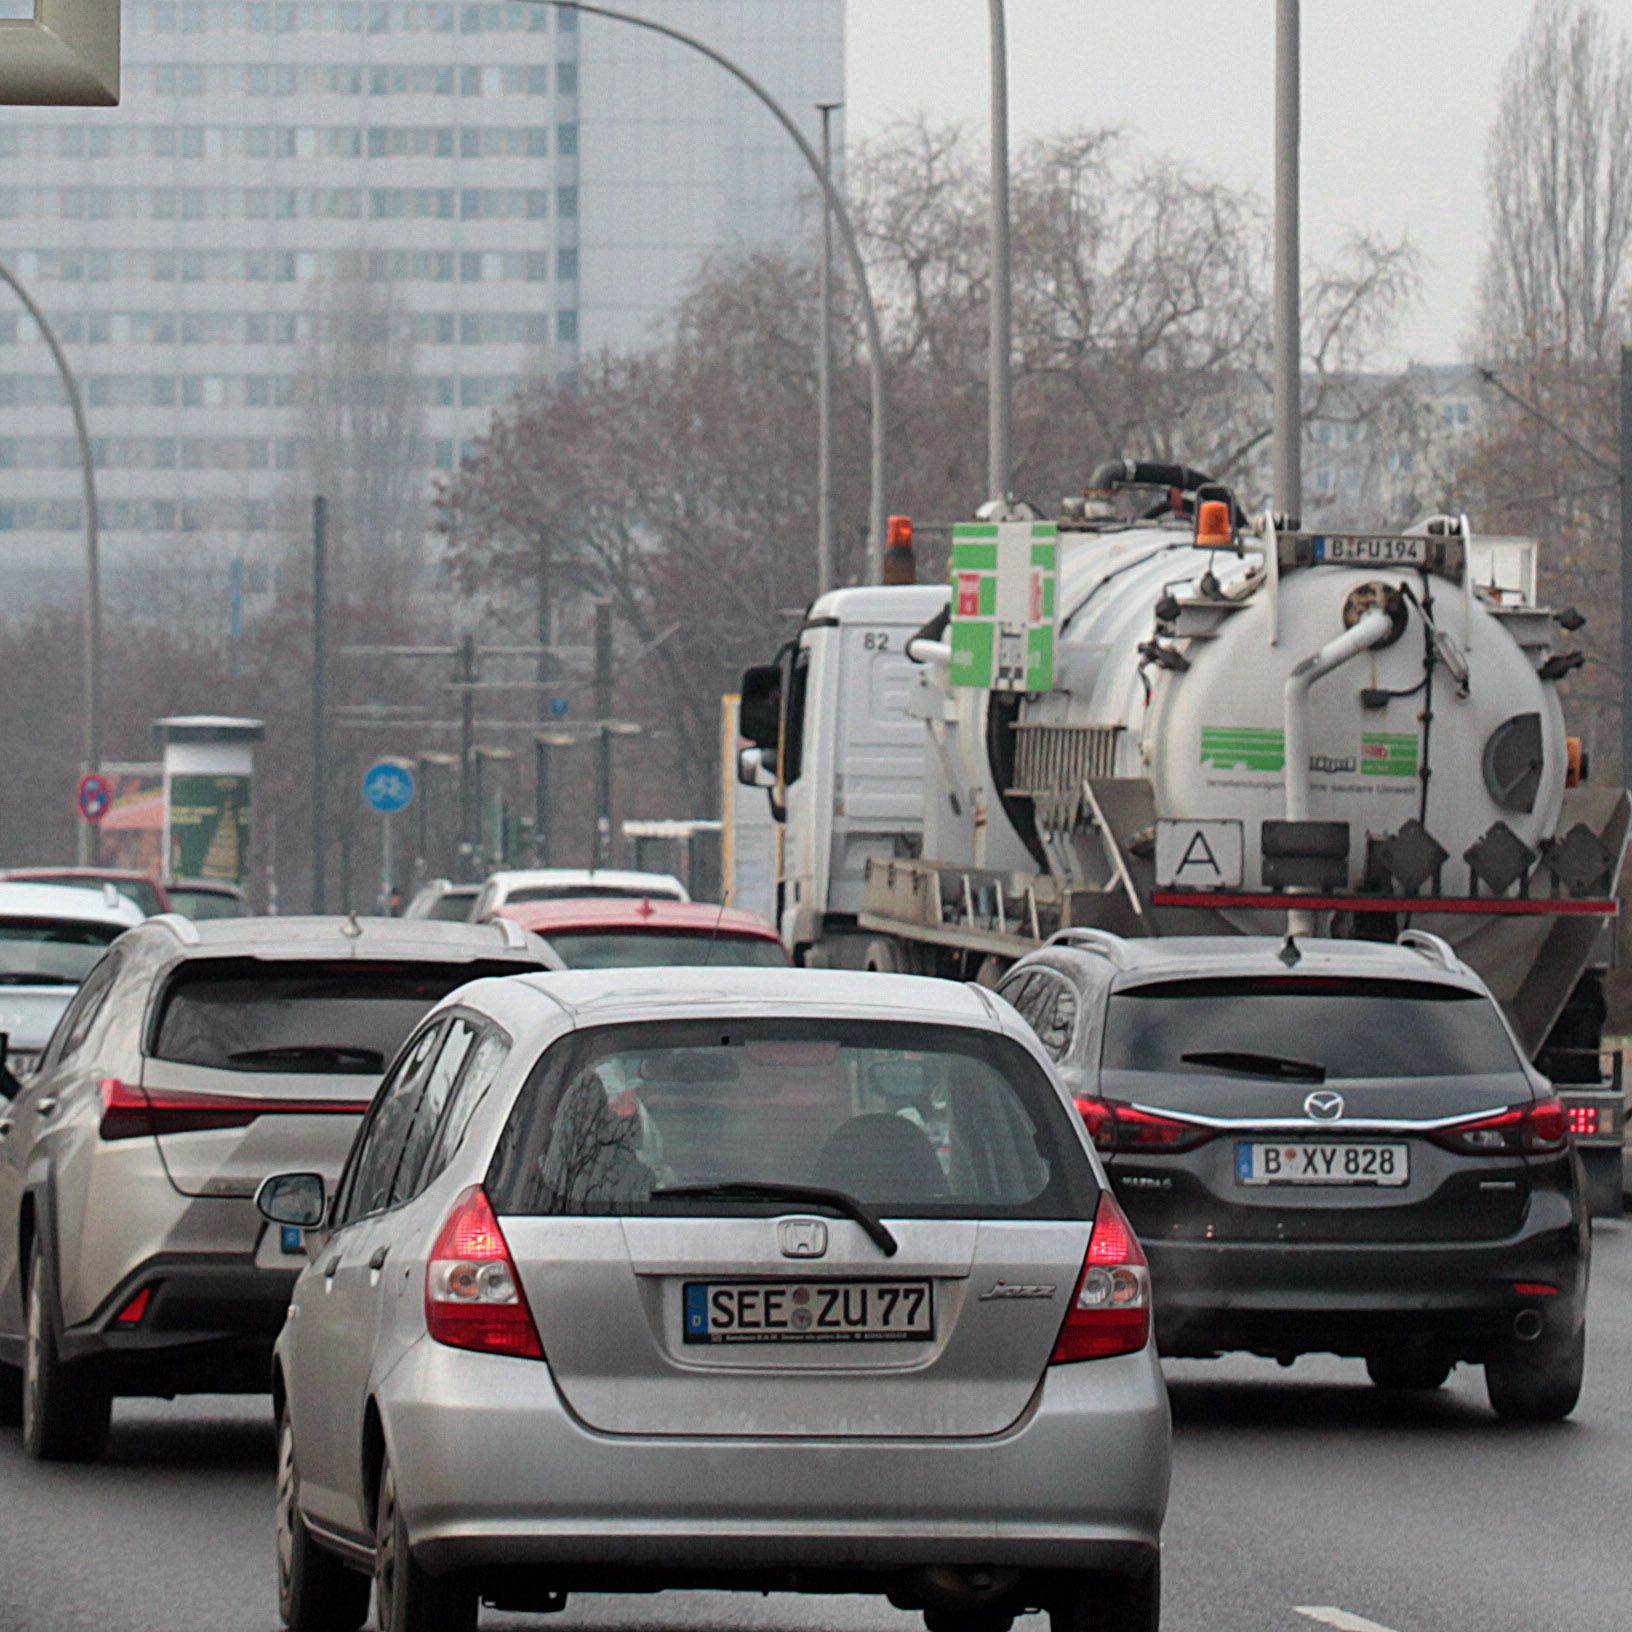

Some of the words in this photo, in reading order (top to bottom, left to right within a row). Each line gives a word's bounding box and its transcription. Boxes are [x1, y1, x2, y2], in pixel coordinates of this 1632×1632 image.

[864, 632, 889, 651] 82
[1176, 830, 1221, 875] A
[1264, 1148, 1281, 1174] B
[1302, 1148, 1336, 1175] XY
[1344, 1148, 1394, 1175] 828
[711, 1290, 788, 1328] SEE
[816, 1288, 869, 1327] ZU
[877, 1288, 925, 1326] 77
